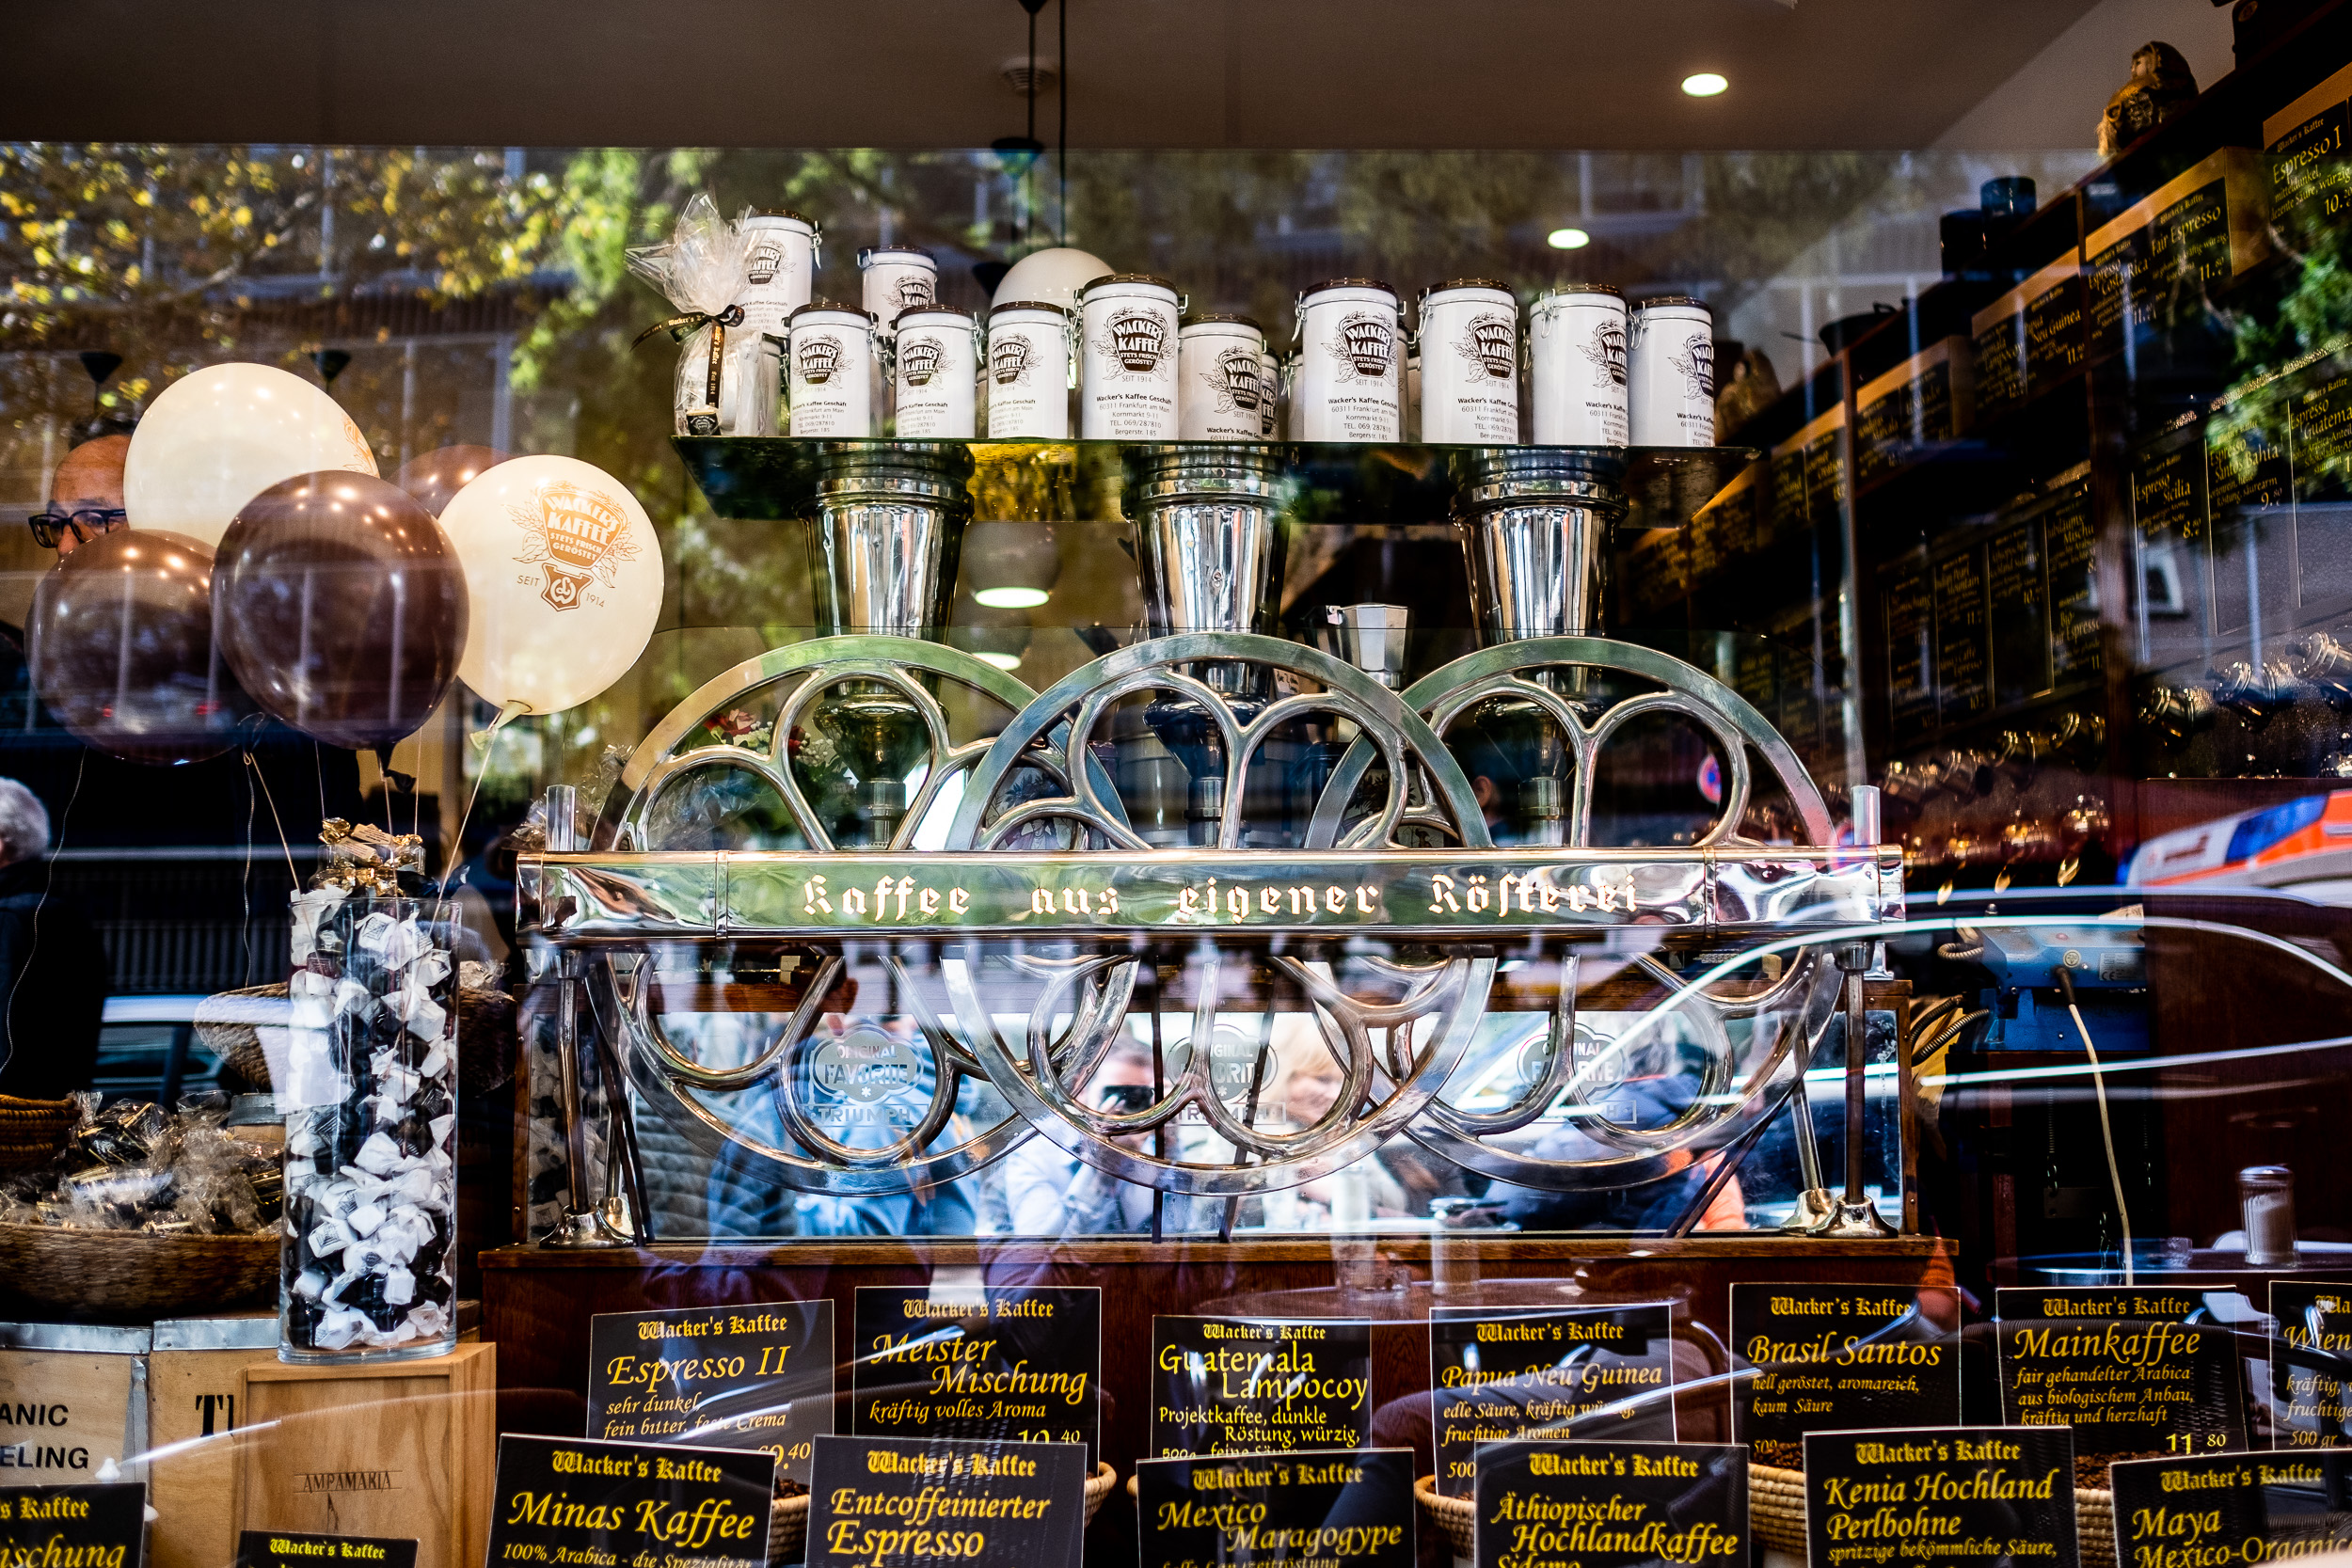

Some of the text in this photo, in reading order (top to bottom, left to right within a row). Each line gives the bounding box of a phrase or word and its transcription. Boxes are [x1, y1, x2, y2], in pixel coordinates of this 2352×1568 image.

[2273, 124, 2342, 184] Espresso I
[2152, 206, 2221, 257] Fair Espresso
[2089, 258, 2121, 292] Espresso
[2128, 258, 2149, 280] Rica
[2049, 309, 2081, 336] Guinea
[1119, 337, 1160, 353] KAFFEE
[1351, 341, 1389, 357] KAFFEE
[1482, 341, 1513, 358] KAFFEE
[803, 357, 834, 370] KAFFEE
[906, 358, 934, 371] KAFFEE
[1124, 357, 1153, 366] GERÖSTET
[1096, 393, 1123, 402] Wacker's
[1120, 403, 1148, 411] Frankfurt
[2290, 399, 2329, 433] Espresso
[2245, 443, 2279, 467] Bahia
[2136, 473, 2169, 504] Espresso
[548, 512, 610, 546] KAFFEE
[549, 532, 602, 554] STETS FRISCH
[552, 542, 597, 561] GERÖSTET
[517, 576, 605, 608] SEIT 1914
[803, 874, 970, 922] Kaffee
[1030, 885, 1120, 916] aus
[1178, 876, 1379, 925] eigener
[837, 1045, 897, 1058] ORIGINAL
[824, 1064, 908, 1085] FAVORITE
[818, 1108, 911, 1122] TRIUMPH
[903, 1299, 1055, 1318] Wacker's Kaffee
[1770, 1296, 1912, 1317] Wacker's Kaffee
[2042, 1297, 2190, 1317] Wacker's Kaffee
[638, 1314, 787, 1340] Wacker's Kaffee
[1203, 1323, 1327, 1339] Wacker's Kaffee
[1476, 1322, 1625, 1342] Wacker's Kaffee
[871, 1332, 997, 1364] Meister
[1159, 1340, 1316, 1374] Guatemala
[1747, 1331, 1942, 1367] Brasil Santos
[2014, 1322, 2201, 1367] Mainkaffee
[607, 1346, 791, 1393] Espresso II
[930, 1359, 1088, 1405] Mischung
[1441, 1362, 1663, 1396] Papua Neu Guinea
[2013, 1367, 2190, 1389] fair gehandelter Arabica
[1222, 1371, 1368, 1410] Lampocoy
[1752, 1373, 1920, 1395] hell geröstet, aromareich,
[2286, 1374, 2341, 1399] kräftig,
[606, 1391, 702, 1415] sehr dunkel,
[1752, 1398, 1834, 1418] kaum Säure
[2018, 1387, 2194, 1408] aus biologischem Anbau,
[869, 1399, 1046, 1424] kräftig volles Aroma
[1159, 1405, 1327, 1429] Projektkaffee, dunkle
[1443, 1400, 1576, 1421] edle Säure, kräftig
[2021, 1408, 2168, 1427] kräftig und herzhaft
[603, 1419, 635, 1440] fein
[736, 1413, 787, 1431] Crema
[1225, 1424, 1360, 1448] Röstung, würzig,
[1440, 1424, 1570, 1447] fruchtige Aromen
[2290, 1431, 2317, 1446] 500
[867, 1450, 1036, 1477] Wacker's Kaffee
[1855, 1440, 2022, 1465] Wacker's Kaffee
[552, 1450, 723, 1482] Wacker's Kaffee
[1192, 1463, 1363, 1491] Wacker's Kaffee
[1447, 1462, 1476, 1479] 500
[1529, 1453, 1699, 1478] Wacker's Kaffee
[2160, 1464, 2324, 1492] Wacker's Kaffee
[1823, 1468, 2060, 1510] Kenia Hochland
[19, 1497, 89, 1520] Kaffee
[831, 1486, 1051, 1526] Entcoffeinierter
[1157, 1497, 1266, 1531] Mexico
[1490, 1491, 1647, 1528] Äthiopischer
[507, 1491, 755, 1549] Minas Kaffee
[1827, 1506, 1962, 1541] Perlbohne
[2132, 1506, 2221, 1546] Maya
[270, 1539, 386, 1560] Wacker's Kaffee
[827, 1519, 984, 1568] Espresso
[1226, 1524, 1403, 1557] Maragogype
[1511, 1521, 1739, 1564] Hochlandkaffee
[1828, 1536, 2058, 1566] spritzige bekömmliche Säure,
[501, 1544, 547, 1560] 100%
[549, 1545, 616, 1567] Arabica
